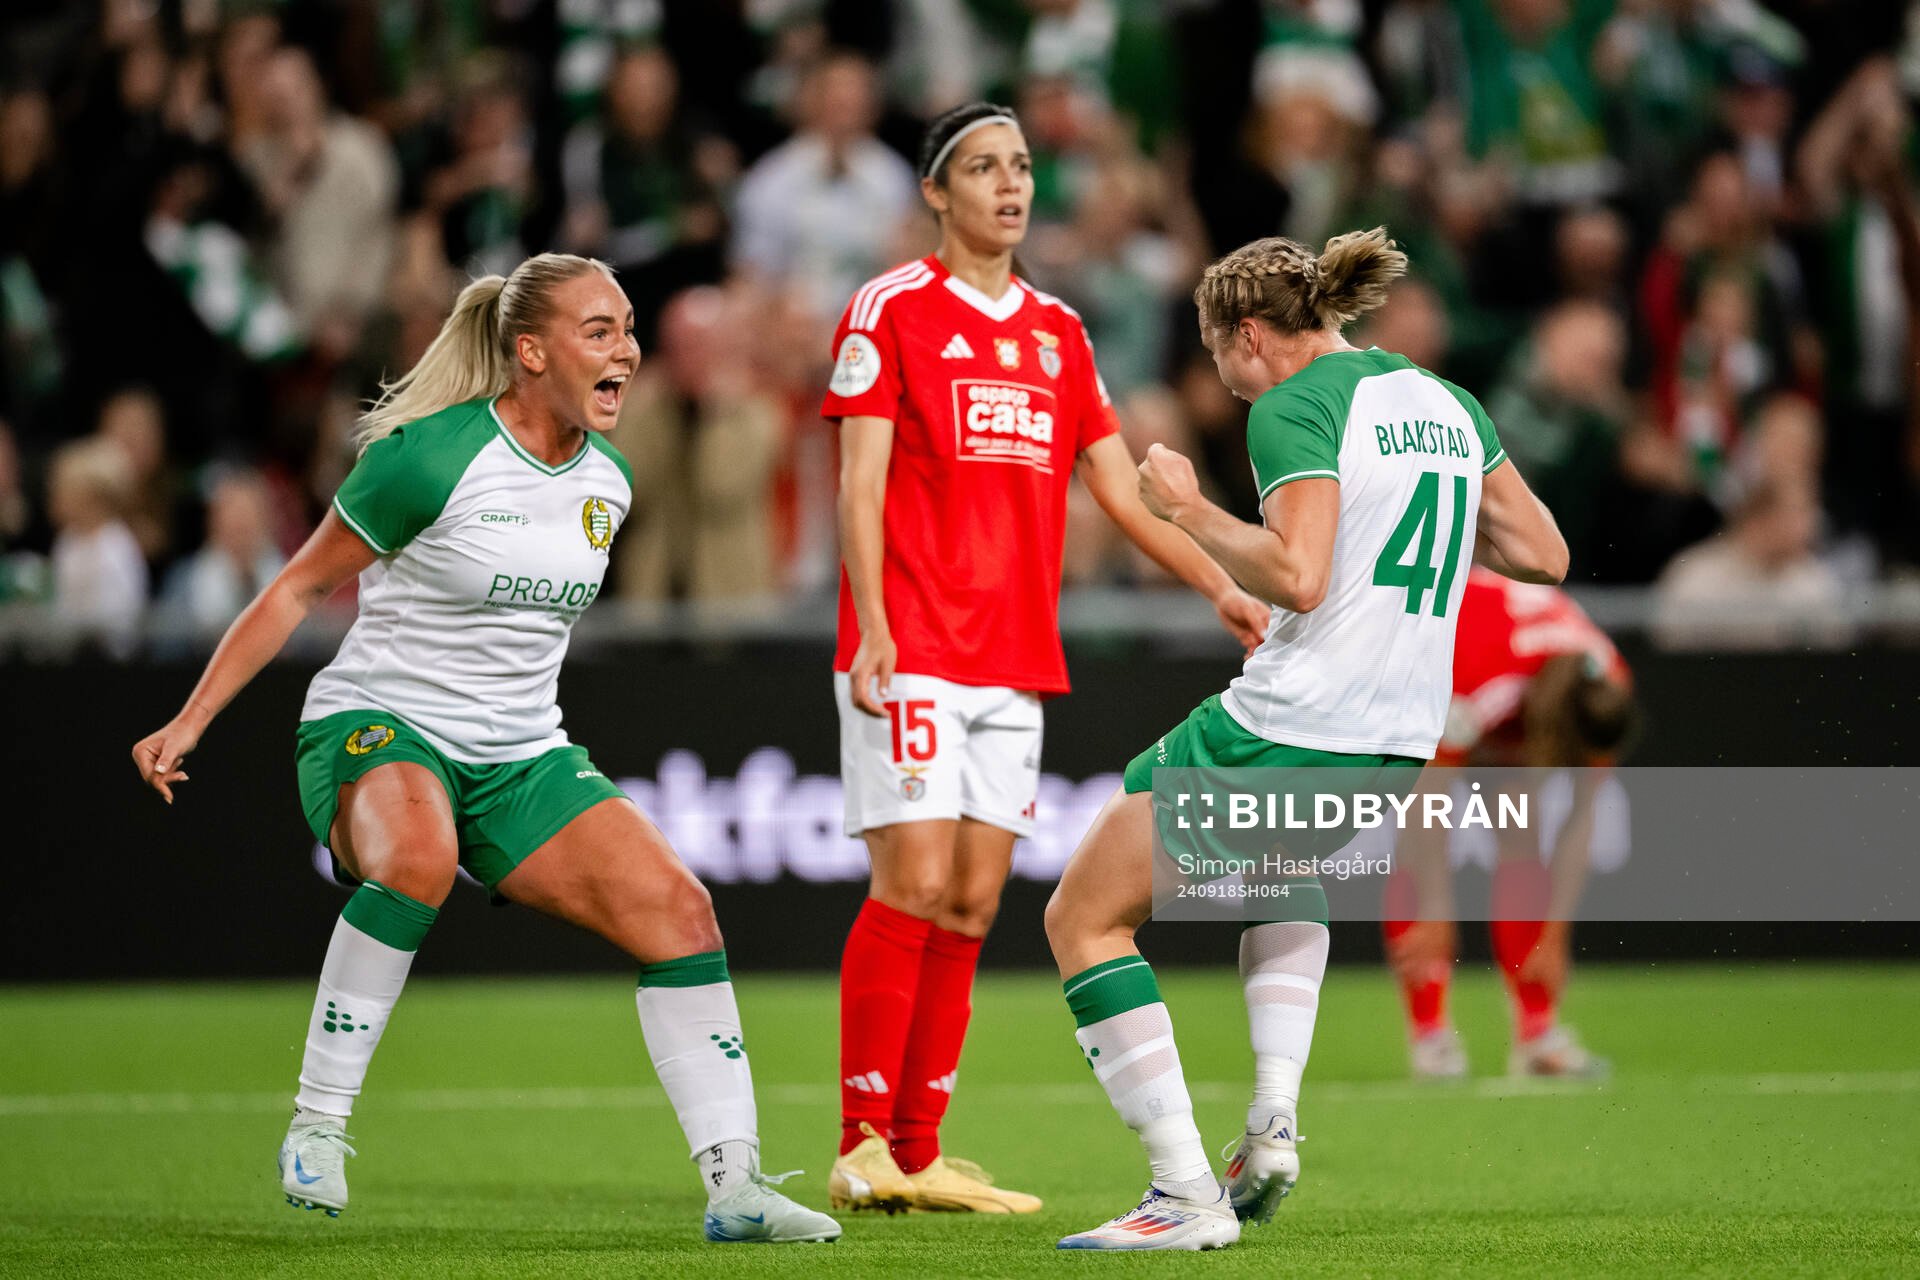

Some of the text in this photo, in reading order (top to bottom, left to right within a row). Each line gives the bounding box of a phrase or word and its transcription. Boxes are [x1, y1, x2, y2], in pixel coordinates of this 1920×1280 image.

[966, 402, 1054, 444] casa
[1375, 420, 1470, 459] BLAKSTAD
[481, 513, 520, 523] CRAFT
[1373, 471, 1467, 618] 41
[883, 700, 937, 763] 15
[1150, 1207, 1201, 1221] F50
